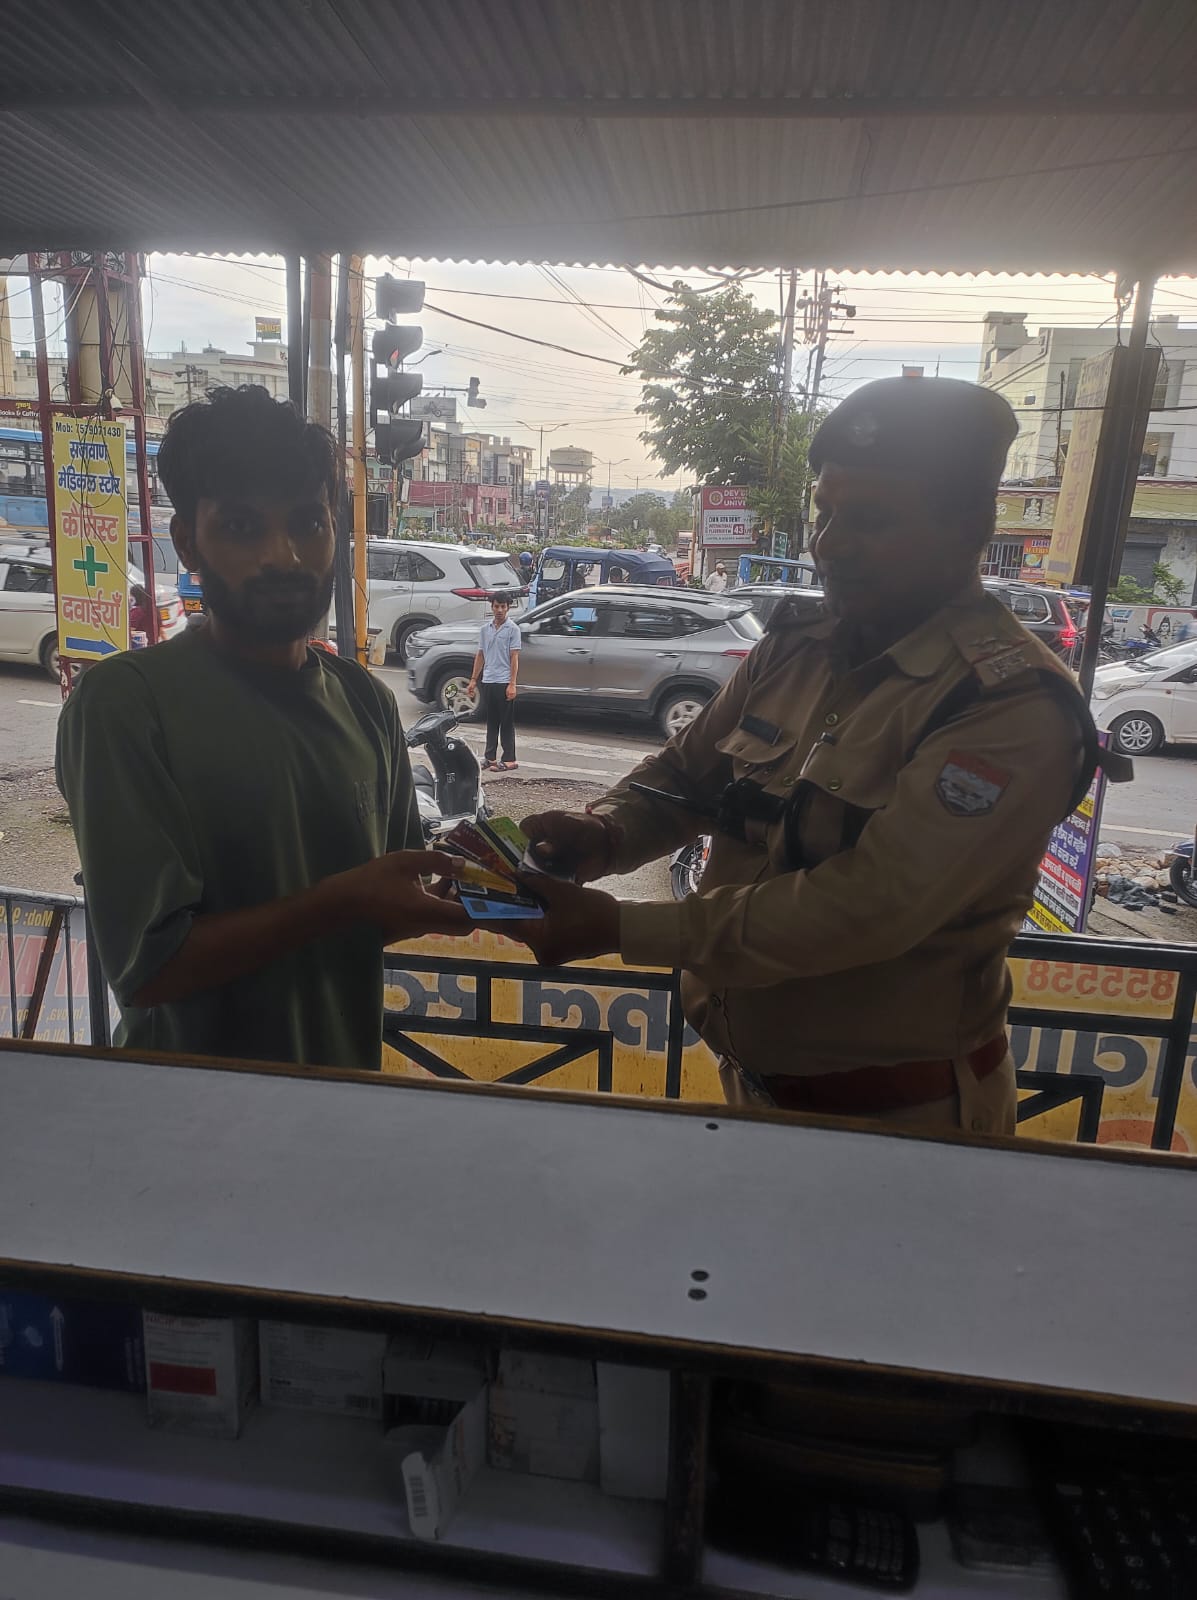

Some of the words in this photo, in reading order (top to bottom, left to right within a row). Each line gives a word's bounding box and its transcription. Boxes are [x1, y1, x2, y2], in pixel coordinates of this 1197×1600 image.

[55, 421, 73, 433] Mob:
[58, 465, 97, 492] मेडिकल
[98, 469, 121, 494] स्टोर
[724, 489, 739, 497] DEV
[733, 525, 744, 535] 43
[62, 590, 123, 628] दवाईयाँ
